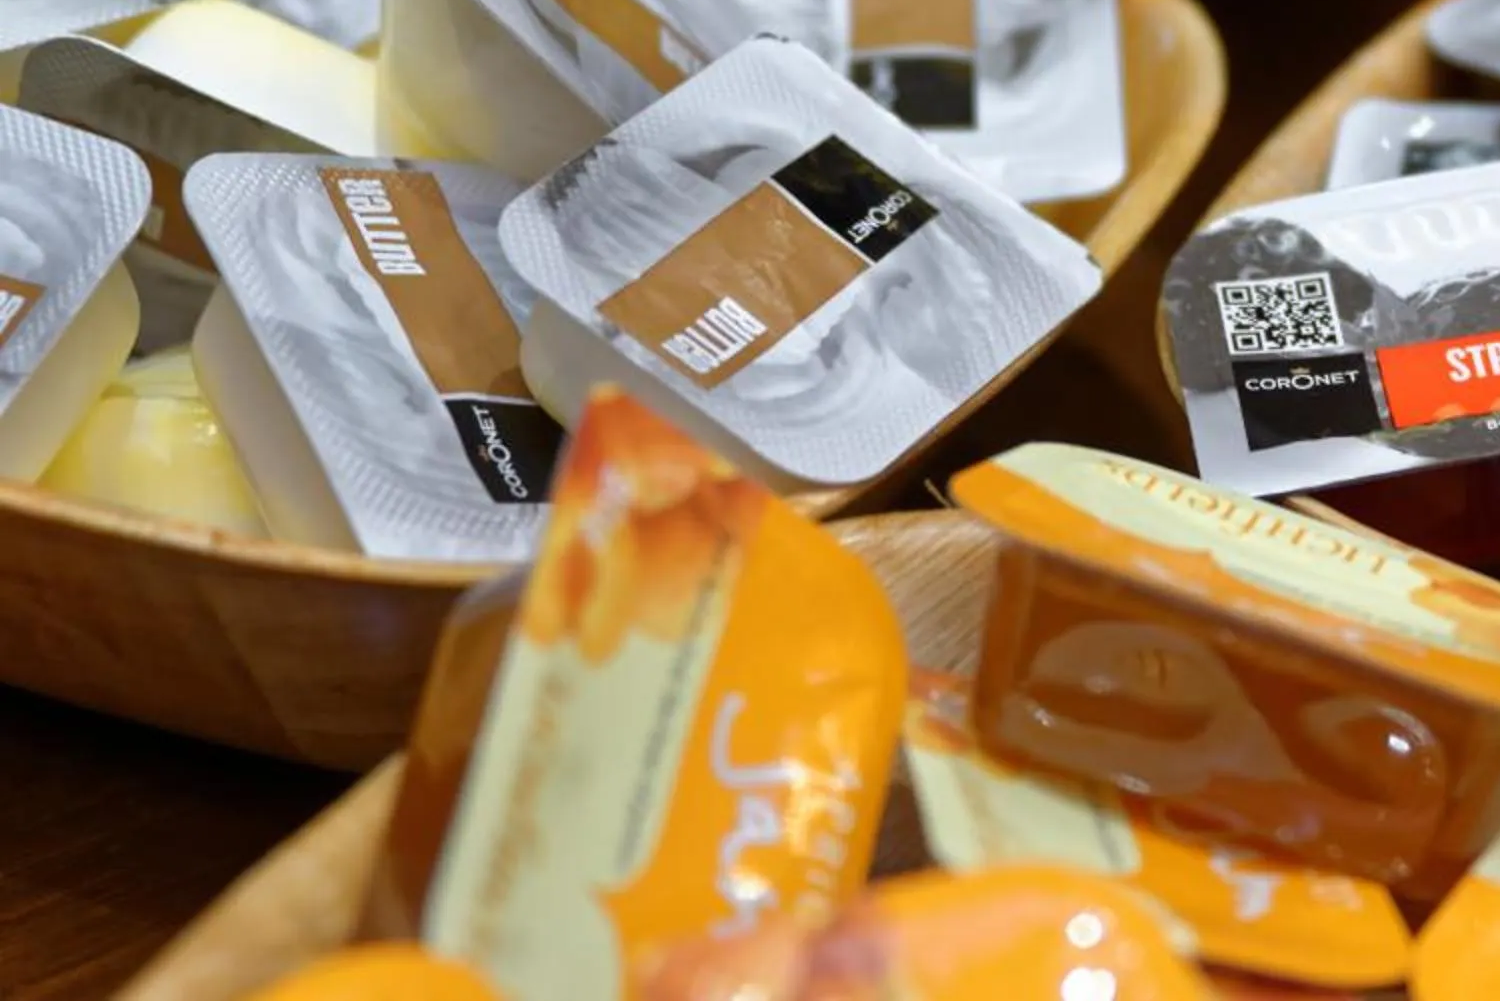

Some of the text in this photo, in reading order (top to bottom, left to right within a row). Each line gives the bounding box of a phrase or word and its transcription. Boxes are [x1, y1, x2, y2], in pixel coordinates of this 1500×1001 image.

[847, 191, 912, 245] CORONET
[1244, 370, 1360, 391] CORONET
[471, 405, 529, 499] CORONET
